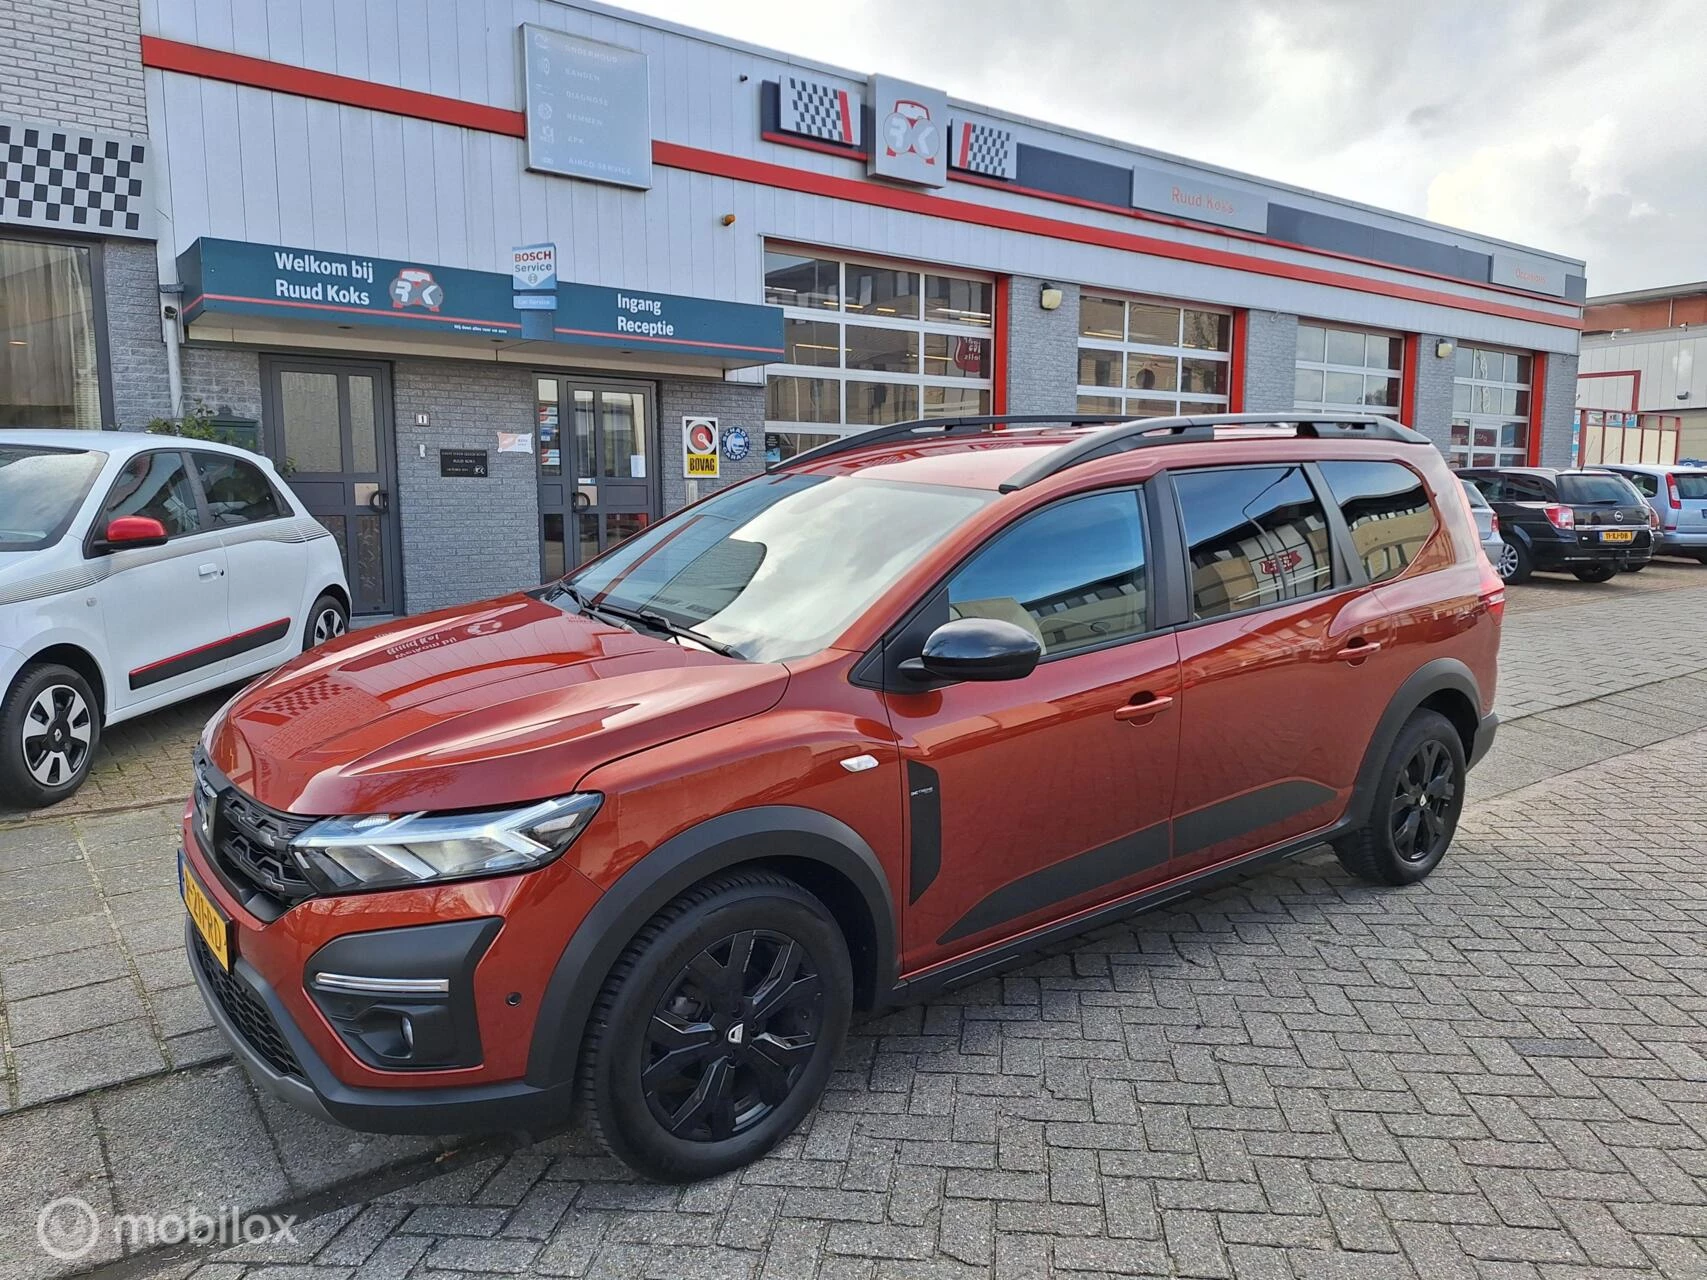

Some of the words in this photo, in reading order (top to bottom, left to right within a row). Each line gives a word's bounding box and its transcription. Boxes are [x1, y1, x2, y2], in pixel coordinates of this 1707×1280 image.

[1171, 186, 1202, 207] Ruud
[1206, 193, 1234, 215] Koks
[274, 252, 347, 276] Welkom
[352, 260, 373, 283] bij
[514, 250, 552, 263] BOSCH
[514, 262, 553, 273] Service
[275, 279, 323, 300] Ruud
[327, 285, 370, 305] Koks
[617, 293, 661, 316] Ingang
[617, 316, 674, 337] Receptie
[689, 457, 715, 472] BOVAG
